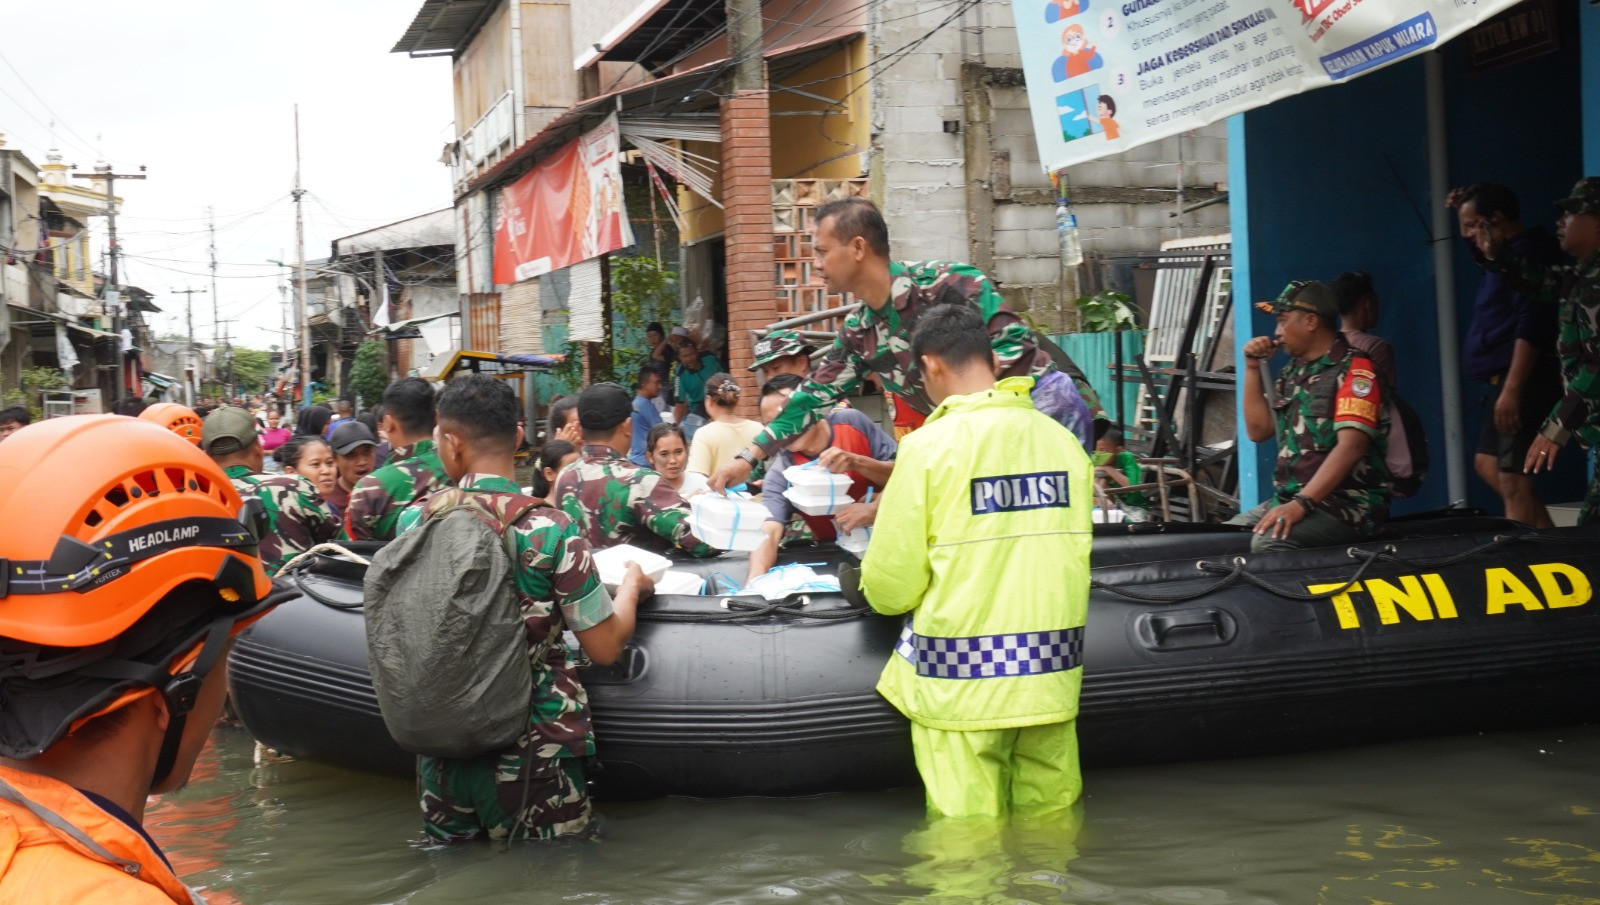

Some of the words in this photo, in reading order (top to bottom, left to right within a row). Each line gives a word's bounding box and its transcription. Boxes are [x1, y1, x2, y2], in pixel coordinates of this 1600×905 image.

[1141, 28, 1174, 48] tempat
[1363, 37, 1396, 60] KAPUK
[1392, 19, 1435, 48] MUARA
[1118, 73, 1124, 86] 3
[1136, 56, 1165, 76] JAGA
[1139, 76, 1164, 90] Buka
[1173, 61, 1201, 82] jendela
[1143, 85, 1191, 109] mendapat
[1192, 74, 1218, 92] cahaya
[1146, 113, 1171, 128] serta
[1214, 91, 1230, 104] alas
[1230, 83, 1248, 98] tidur
[1249, 78, 1267, 92] agar
[1266, 68, 1285, 84] tidak
[974, 475, 1068, 511] POLISI
[129, 525, 200, 552] HEADLAMP
[94, 568, 122, 584] VERTEX
[1307, 573, 1459, 630] TNI
[1485, 562, 1593, 615] AD
